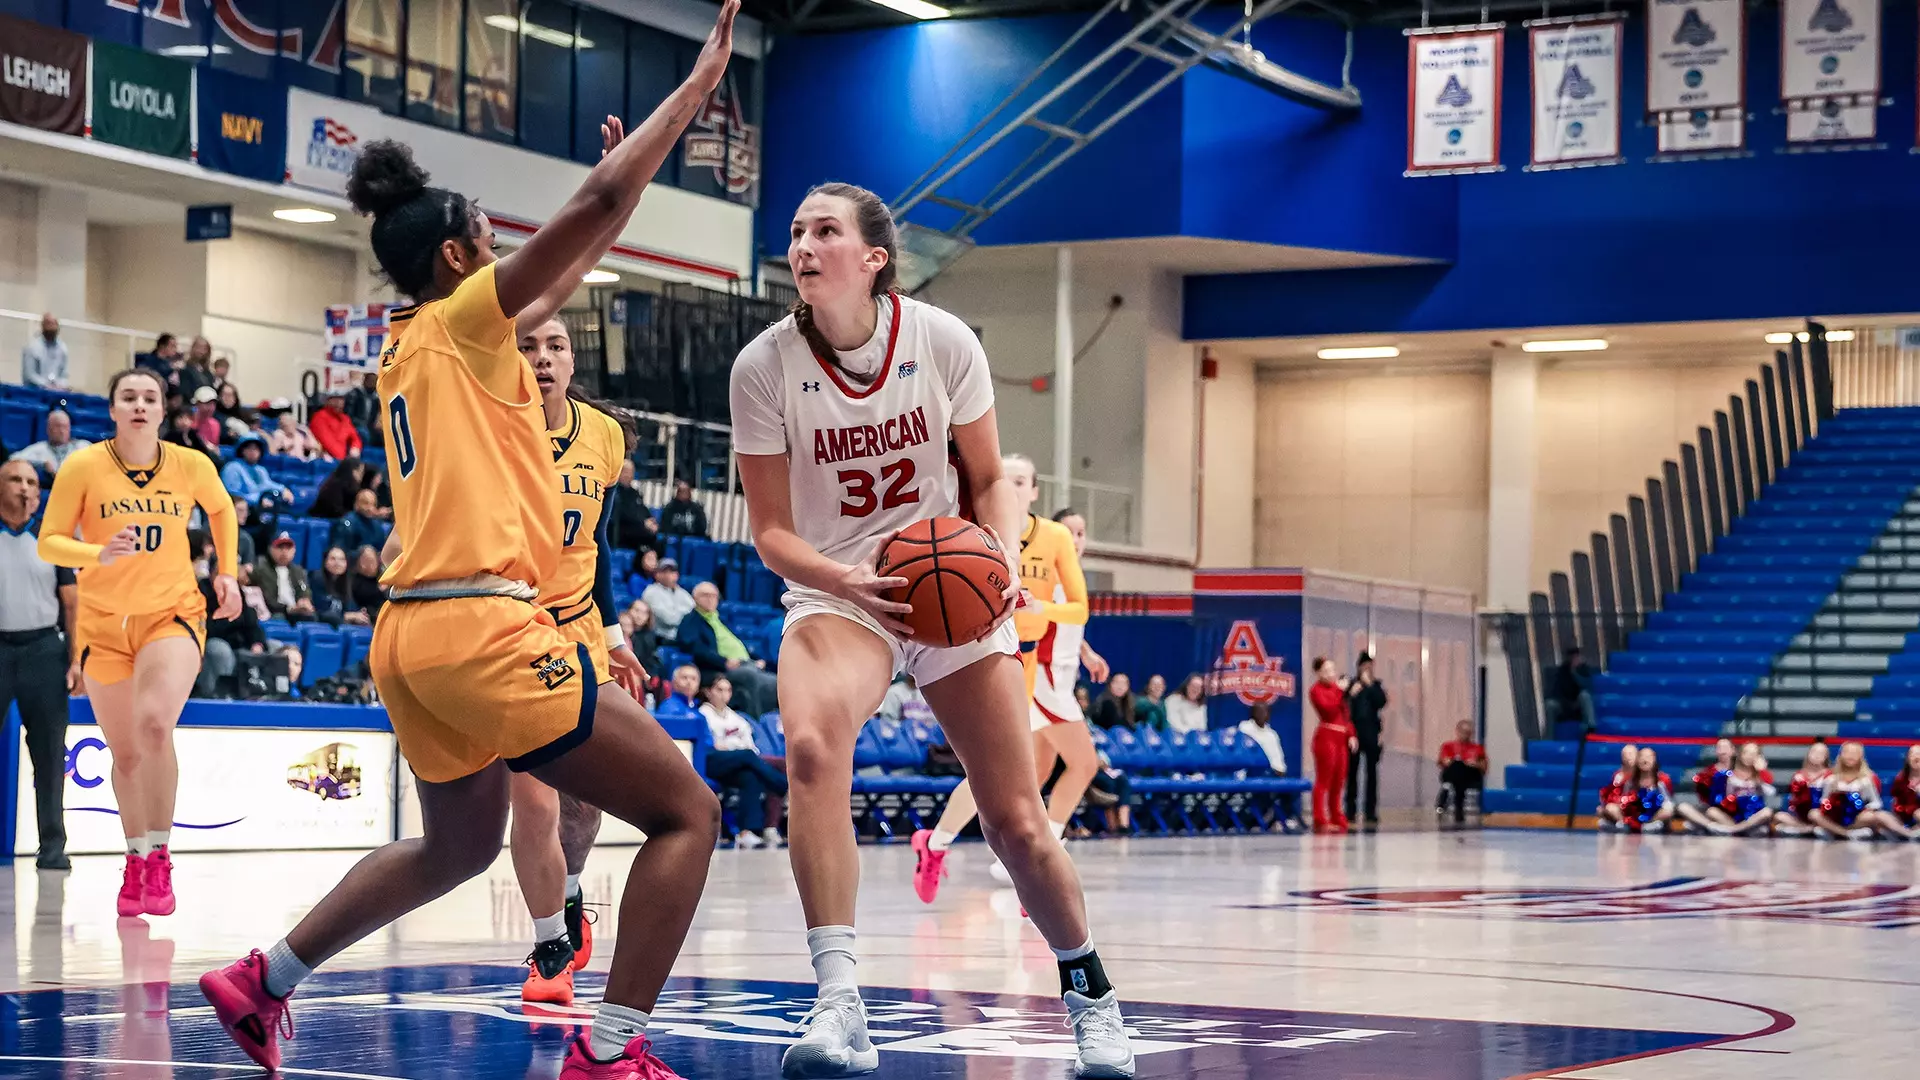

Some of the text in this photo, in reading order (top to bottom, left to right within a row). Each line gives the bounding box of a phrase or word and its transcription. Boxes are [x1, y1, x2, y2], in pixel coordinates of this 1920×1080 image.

[3, 54, 70, 98] LEHIGH
[109, 79, 176, 120] LOYOLA
[221, 112, 264, 144] NAVY
[389, 392, 418, 481] 0
[814, 406, 930, 465] AMERICAN
[837, 458, 920, 517] 32
